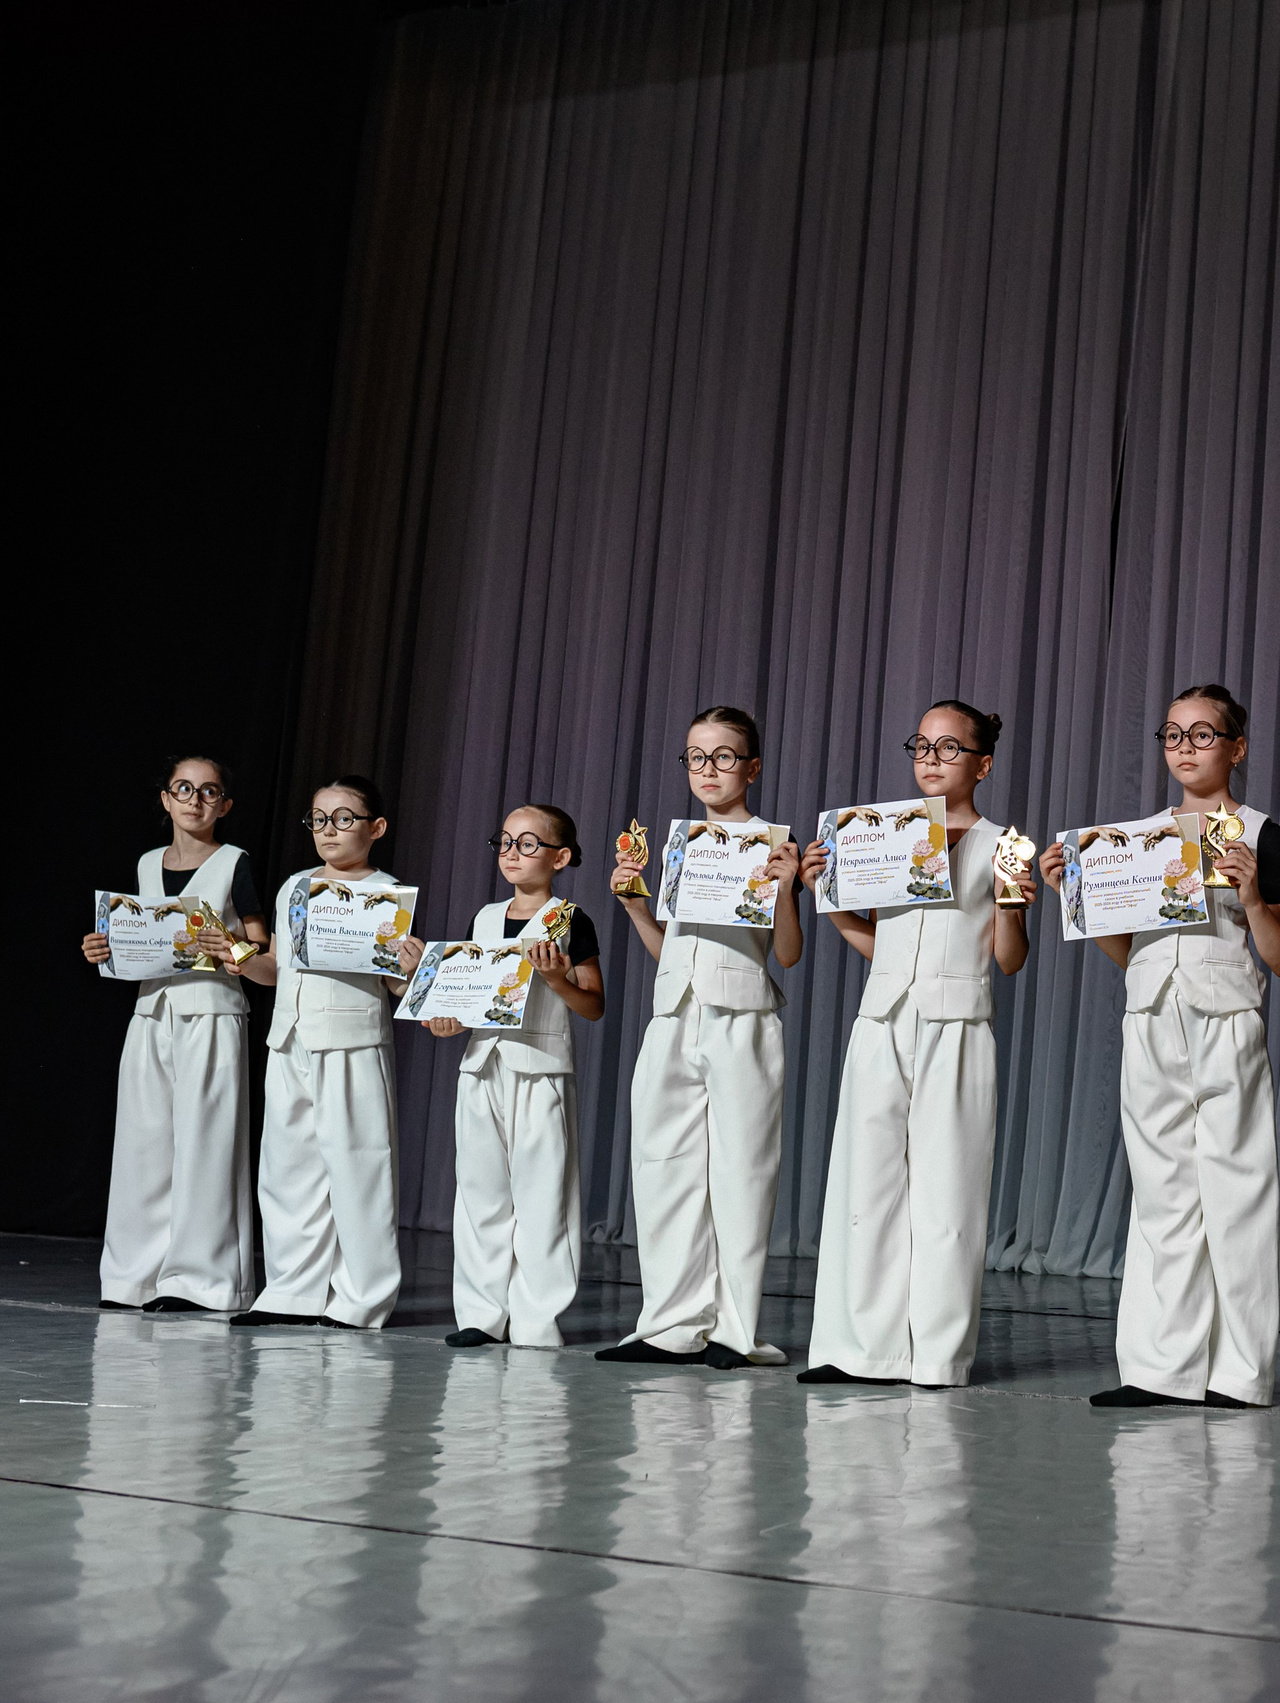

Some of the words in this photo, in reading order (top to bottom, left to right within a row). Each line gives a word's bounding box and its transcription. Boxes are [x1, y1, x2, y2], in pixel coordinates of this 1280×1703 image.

[841, 832, 885, 846] ДИПЛОМ
[688, 849, 730, 860] ДИПЛОМ
[839, 856, 880, 868] Некрасова
[882, 853, 907, 862] Алиса
[1085, 853, 1134, 869] ДИПЛОМ
[684, 869, 714, 881] Фролова
[716, 872, 746, 884] Варвара
[1083, 878, 1130, 893] Румянцева
[1132, 874, 1163, 885] Ксения
[311, 905, 354, 916] ДИПЛОМ
[112, 918, 148, 928] ДИПЛОМ
[309, 924, 336, 936] Юрина
[339, 926, 374, 938] Василиса
[149, 937, 172, 948] София
[441, 965, 482, 974] ДИПЛОМ
[433, 982, 464, 992] Егорова
[465, 983, 493, 991] Анисия
